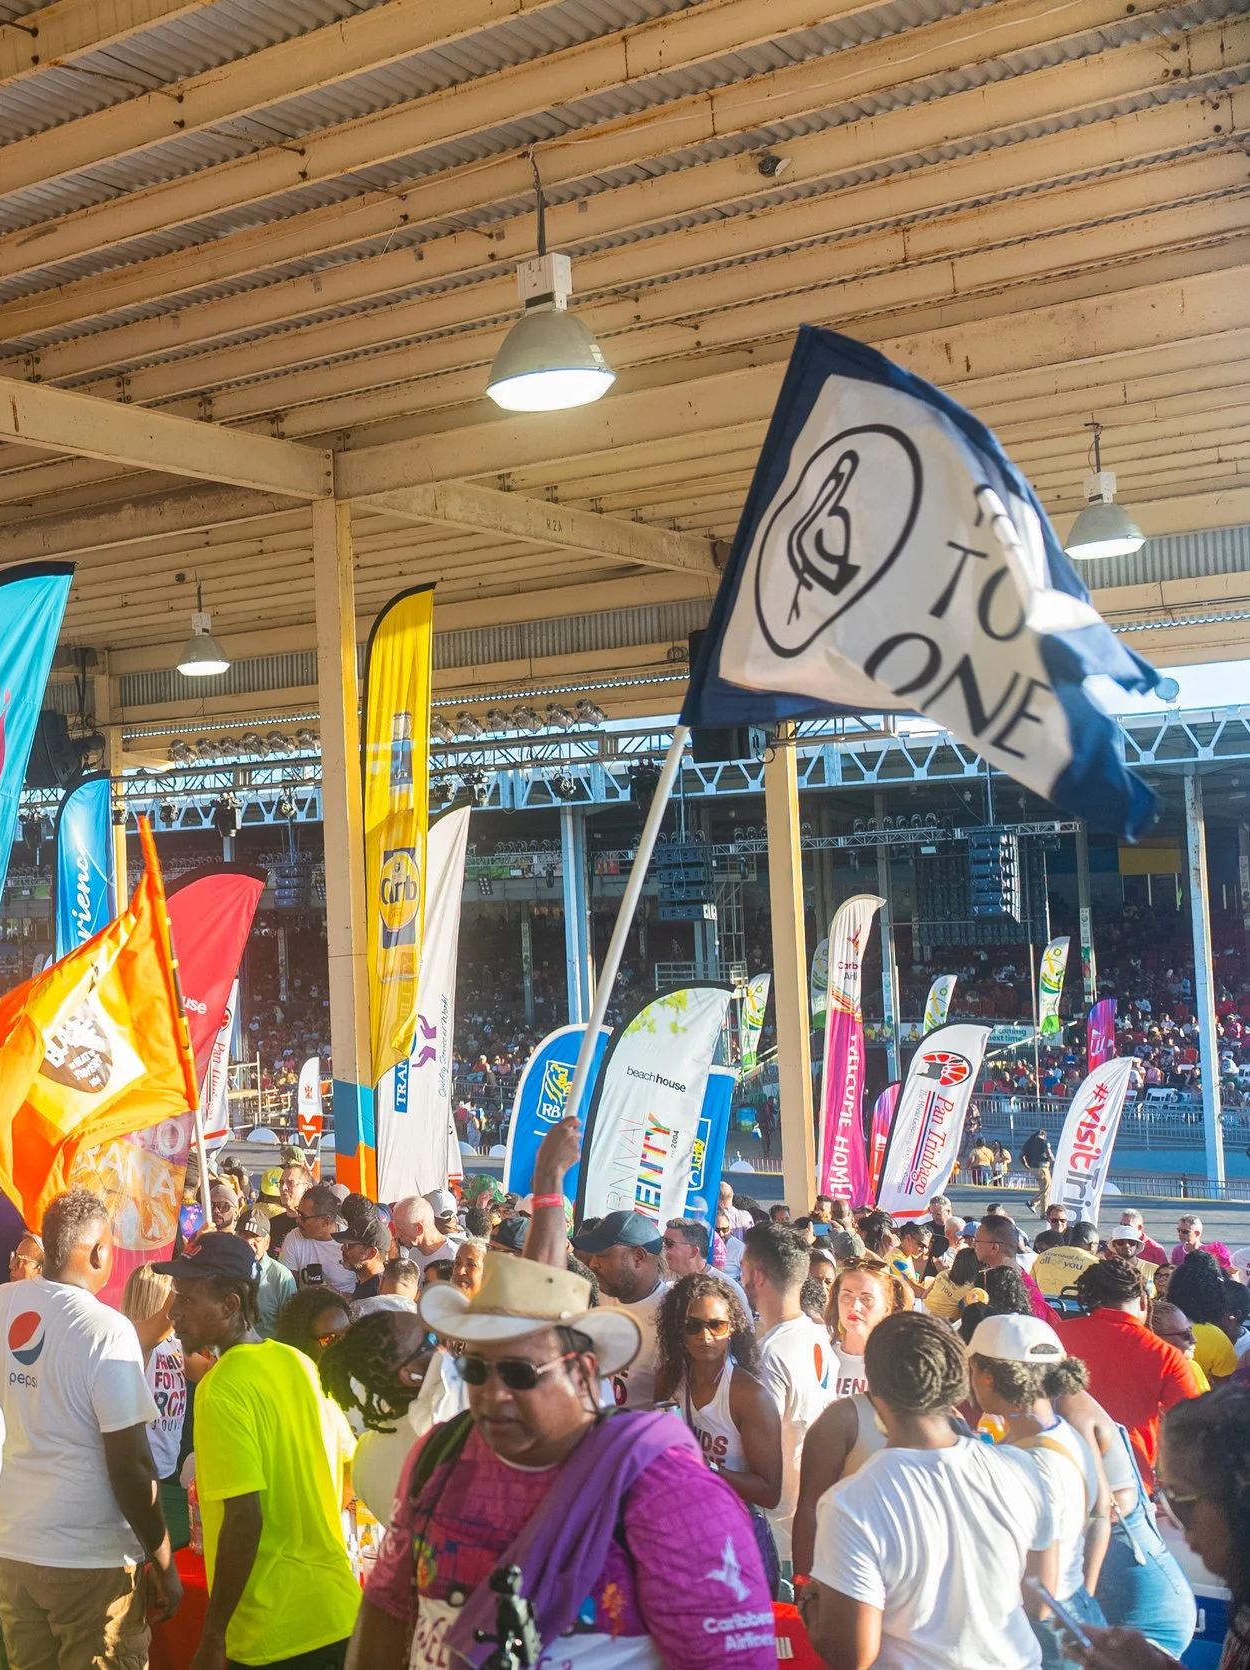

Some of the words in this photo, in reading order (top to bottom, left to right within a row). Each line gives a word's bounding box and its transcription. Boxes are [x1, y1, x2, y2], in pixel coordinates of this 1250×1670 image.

[929, 541, 1025, 641] TO
[863, 632, 1052, 760] ONE
[182, 996, 208, 1015] use
[626, 1065, 687, 1093] beachhouse
[542, 1103, 565, 1119] RB
[931, 1094, 955, 1126] Pan
[671, 1130, 680, 1149] 2004
[1062, 1083, 1109, 1226] #visitTrin
[606, 1112, 646, 1212] RNIVAL
[829, 1135, 853, 1201] HOME!
[910, 1128, 947, 1196] Trinbago
[1040, 1257, 1050, 1265] all
[1064, 1261, 1083, 1272] you
[9, 1371, 38, 1389] pepsi
